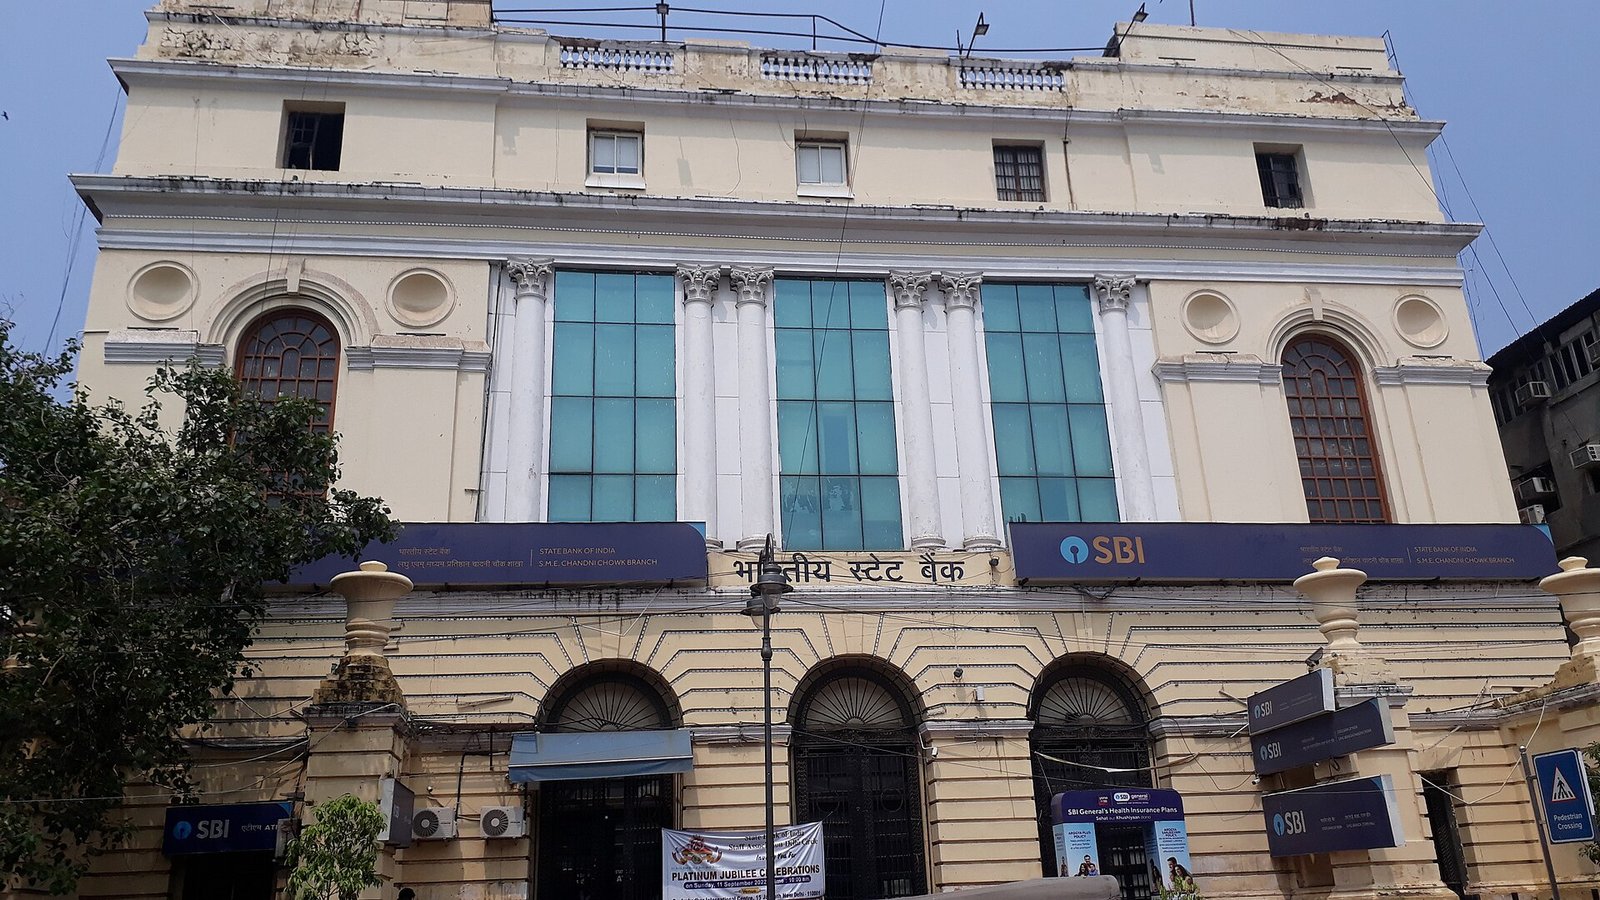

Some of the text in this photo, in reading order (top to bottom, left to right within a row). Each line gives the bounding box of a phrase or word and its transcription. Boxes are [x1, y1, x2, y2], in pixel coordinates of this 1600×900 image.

[1092, 536, 1145, 564] SBI
[538, 560, 561, 568] S.M.E.
[733, 553, 965, 583] भातीय स्टेट बैंक
[1261, 701, 1273, 718] SBI
[1267, 741, 1282, 759] SBI
[1079, 807, 1109, 816] General's
[1130, 806, 1161, 814] Insurance
[1553, 813, 1583, 821] Pedestrian
[196, 819, 230, 839] SBI
[241, 823, 262, 833] एटीएम
[1284, 810, 1307, 835] SBI
[1557, 821, 1583, 830] Crossing
[672, 864, 820, 881] PLATINUM JUBILEE CEBRATIONS
